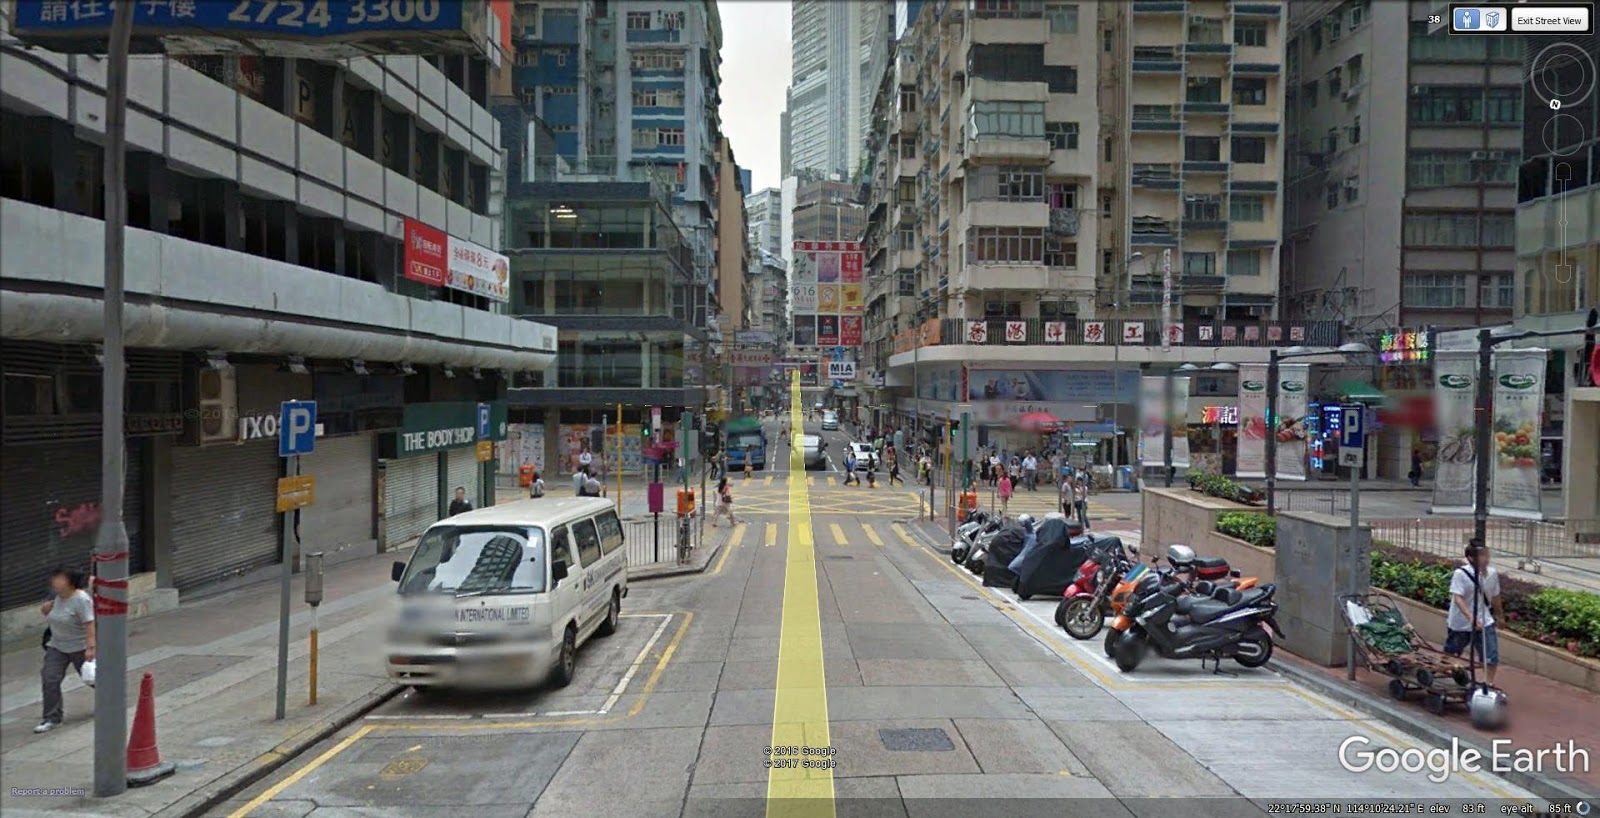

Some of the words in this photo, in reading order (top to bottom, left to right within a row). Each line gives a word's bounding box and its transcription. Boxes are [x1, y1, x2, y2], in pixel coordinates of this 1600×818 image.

[227, 0, 332, 28] 2724
[346, 0, 440, 24] 3300
[830, 363, 853, 373] MIA
[289, 408, 310, 450] P
[480, 409, 489, 437] P
[1344, 409, 1359, 445] P
[402, 431, 426, 452] THE
[427, 428, 453, 449] BODY
[459, 607, 505, 623] INTERNATIONAL
[506, 606, 530, 621] LIMITED
